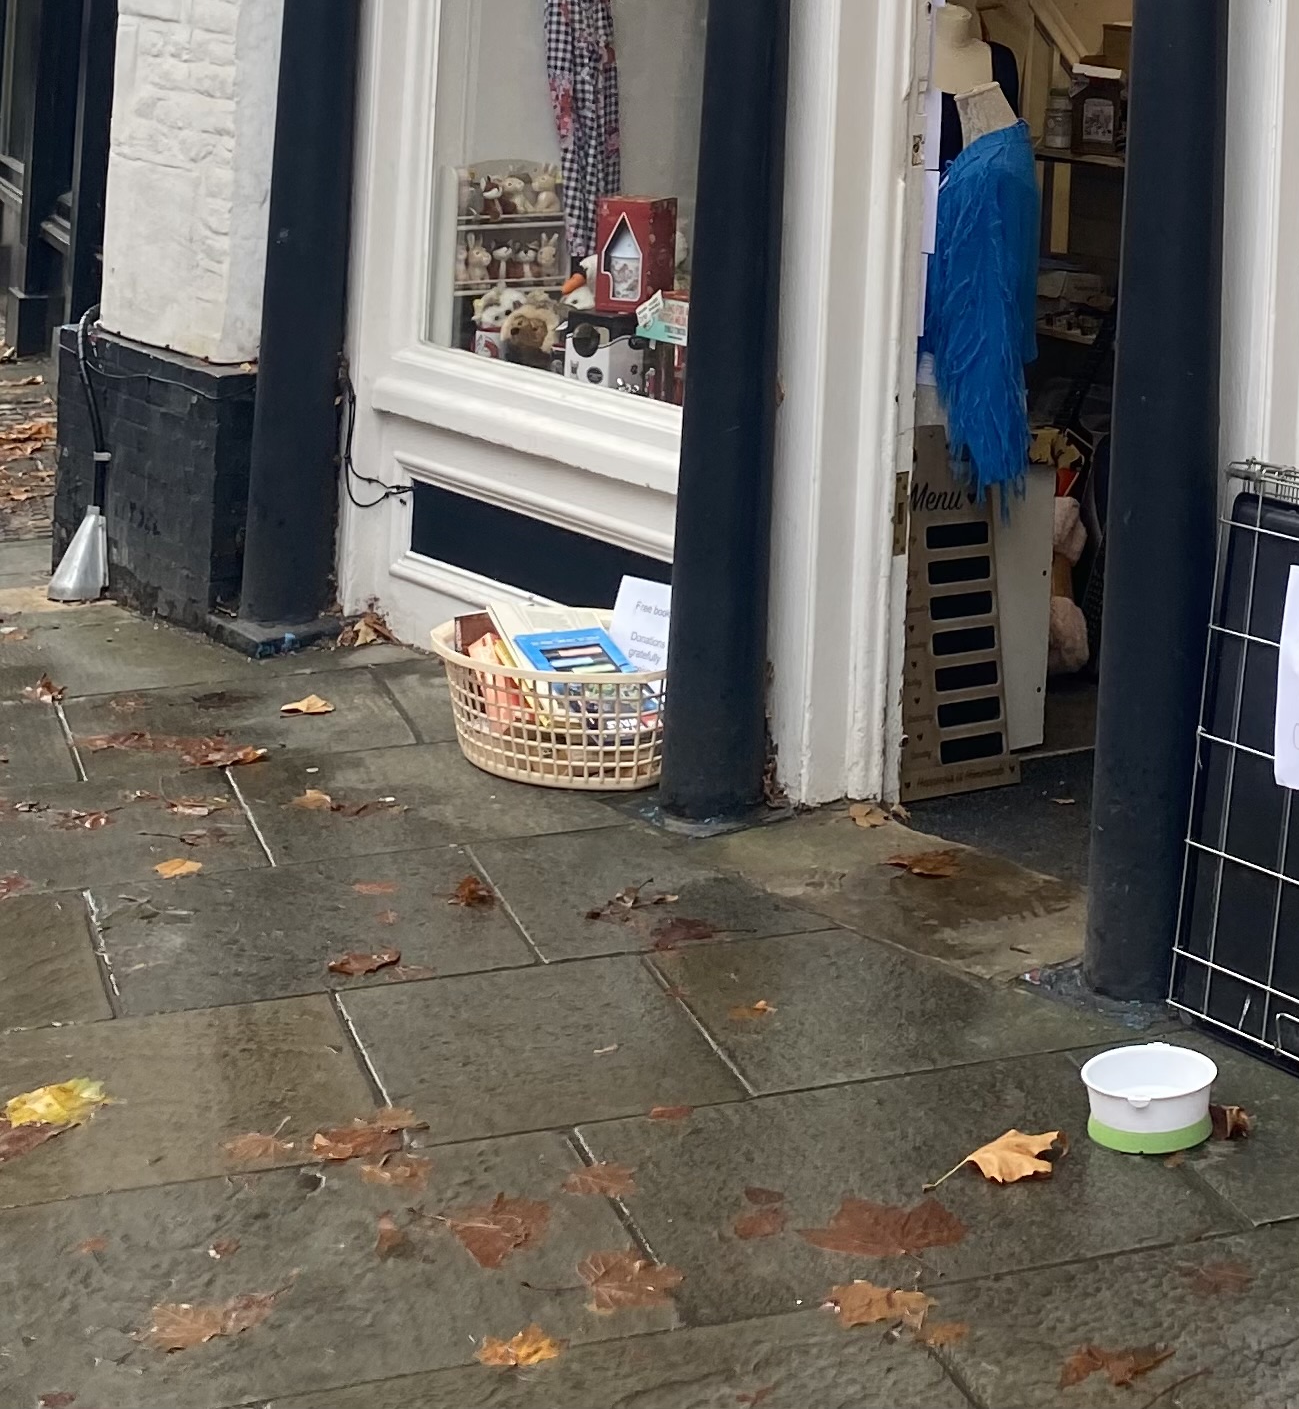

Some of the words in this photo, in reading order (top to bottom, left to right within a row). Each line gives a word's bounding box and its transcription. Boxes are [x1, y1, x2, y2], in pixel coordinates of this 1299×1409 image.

[911, 482, 963, 511] Menu
[635, 601, 653, 614] Free
[630, 631, 666, 649] Donations
[628, 648, 662, 666] gratefully
